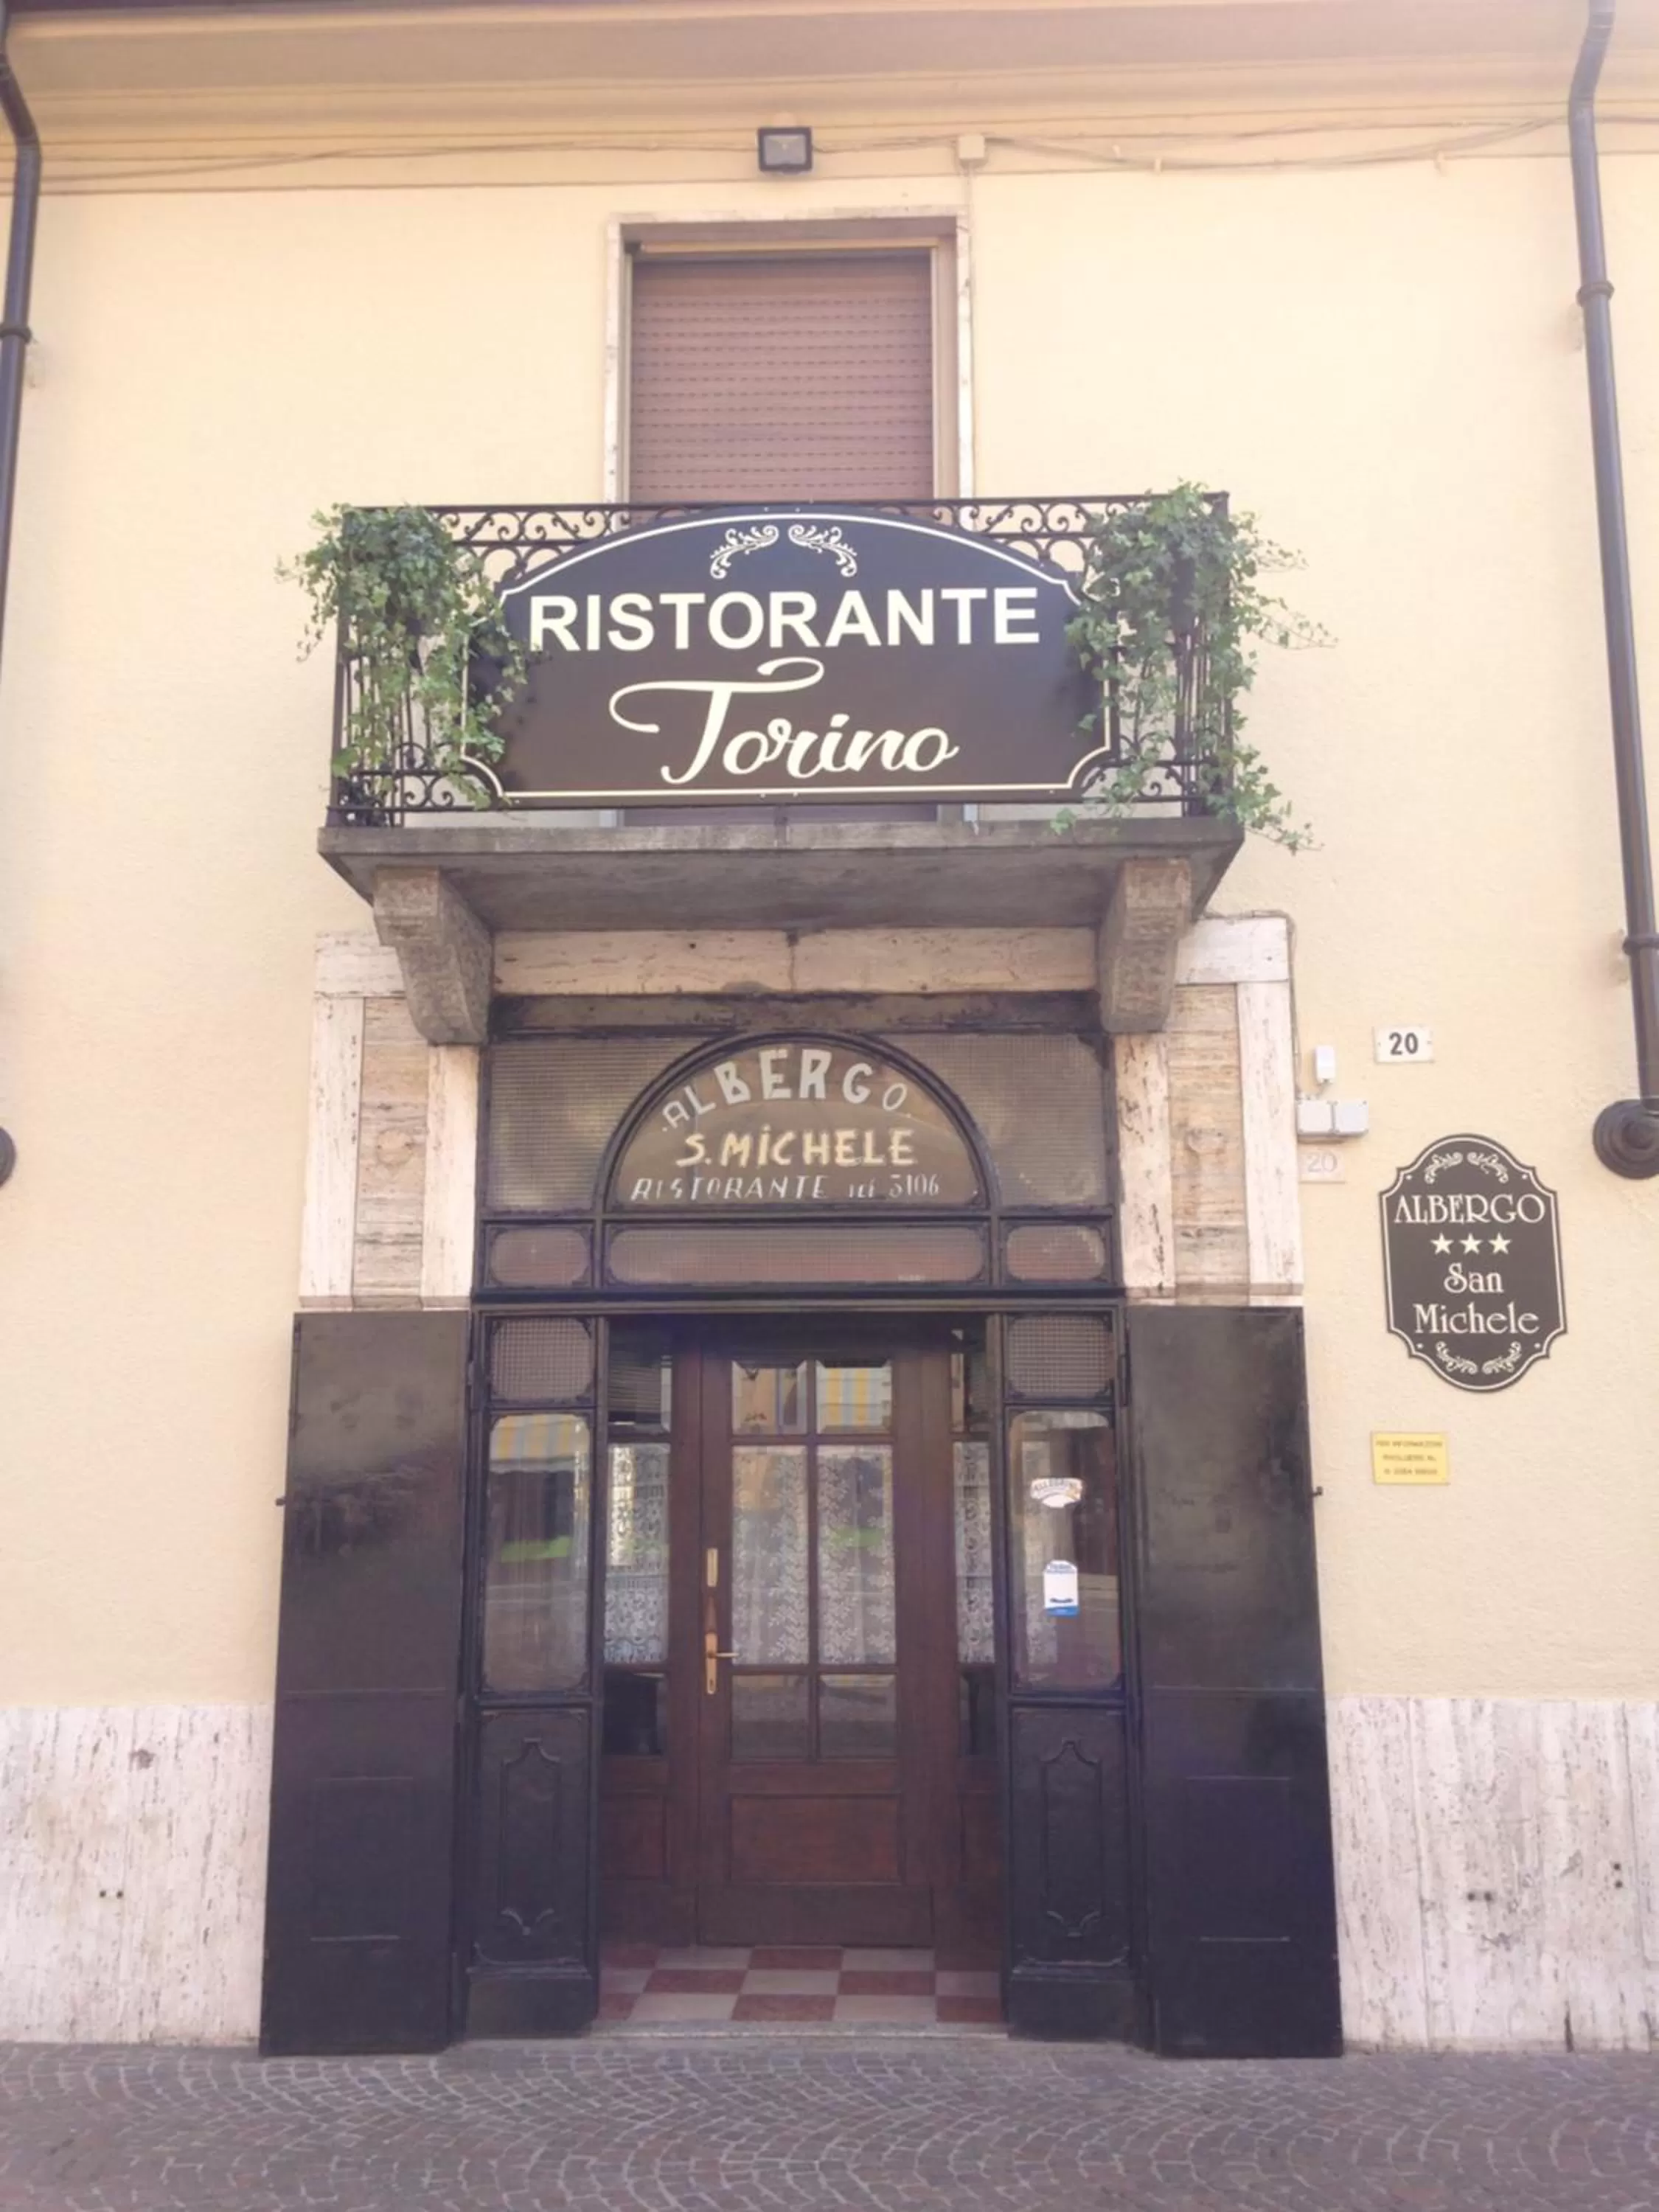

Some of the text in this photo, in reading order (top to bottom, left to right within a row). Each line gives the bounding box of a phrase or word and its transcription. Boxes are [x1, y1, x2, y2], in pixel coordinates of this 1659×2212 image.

[529, 587, 1040, 652] RISTORANTE
[609, 657, 959, 785] Torino
[1388, 1032, 1419, 1055] 20
[662, 1048, 908, 1131] ALBERGO
[630, 1174, 830, 1201] RISTORANTE
[1394, 1194, 1545, 1225] ALBERGO
[1444, 1262, 1504, 1293] San
[1413, 1301, 1540, 1334] Michele
